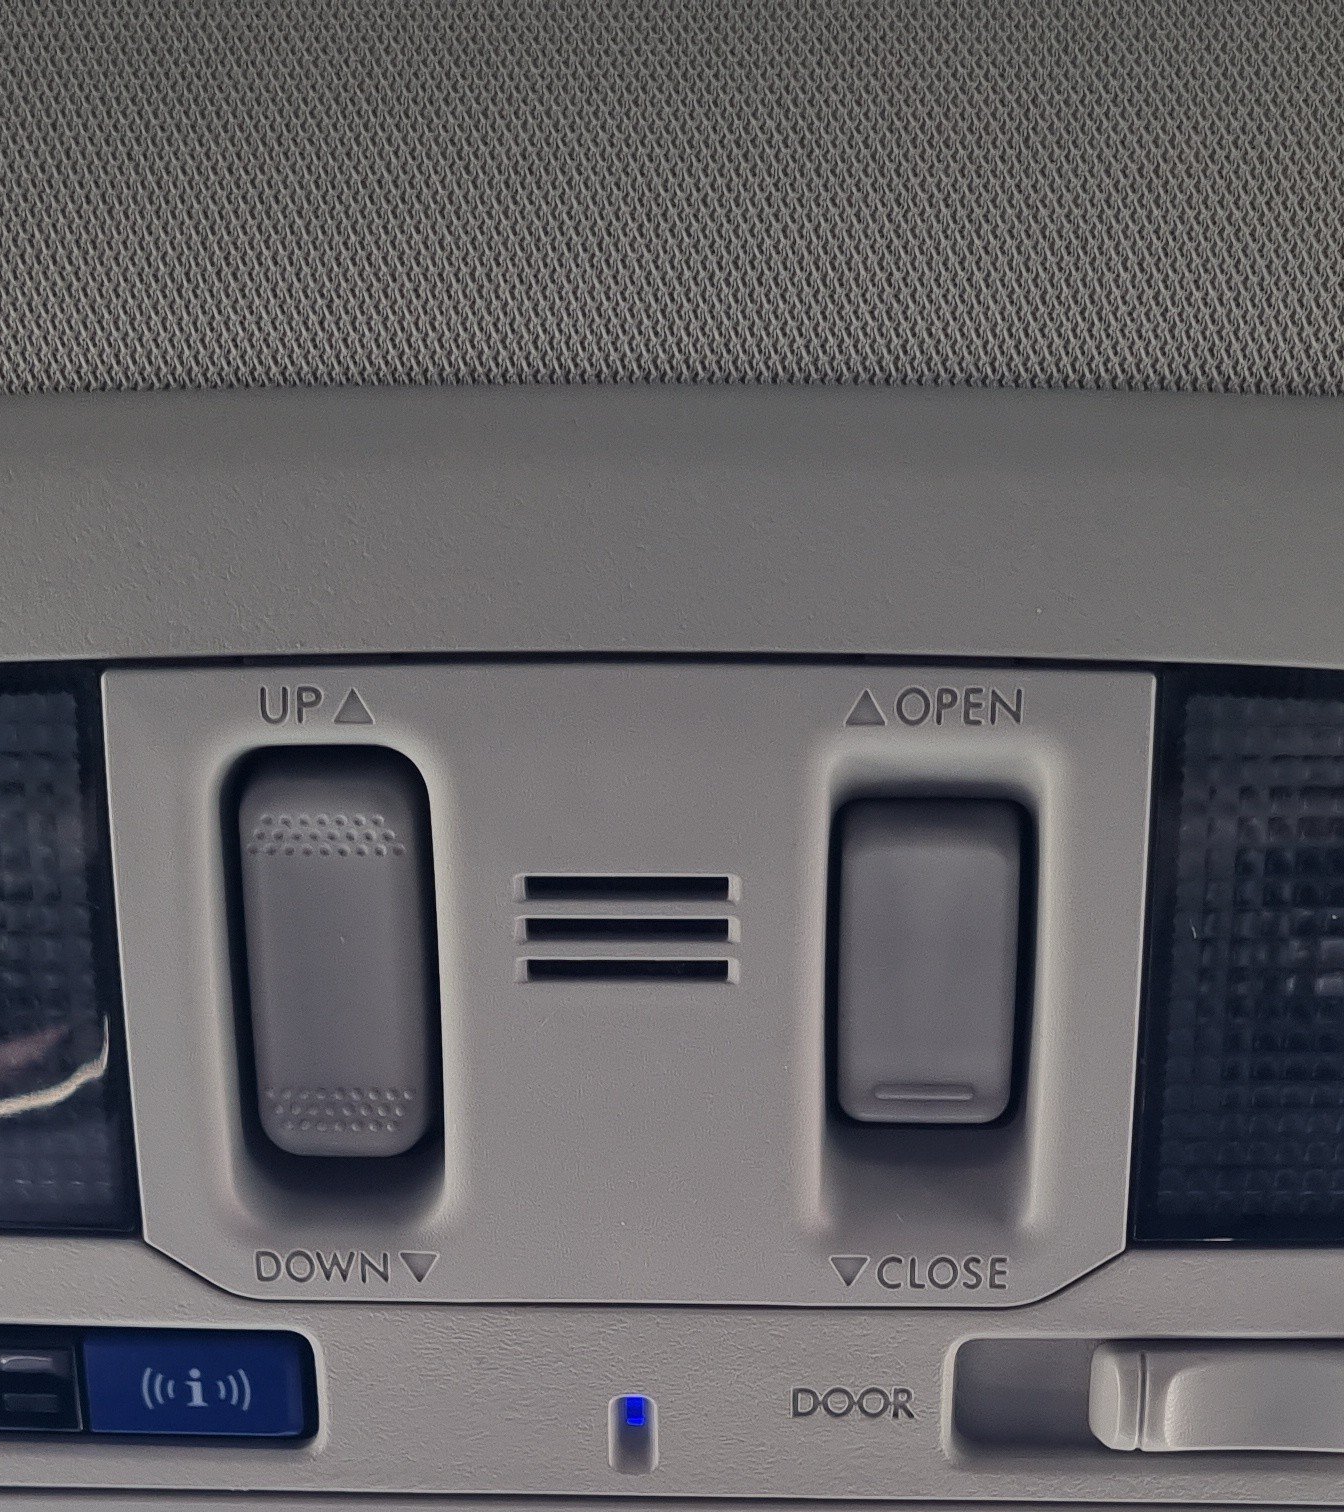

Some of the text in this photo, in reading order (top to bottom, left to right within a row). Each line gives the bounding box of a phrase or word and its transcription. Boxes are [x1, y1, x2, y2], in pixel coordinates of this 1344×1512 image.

[260, 686, 322, 725] UP
[895, 687, 1024, 726] OPEN
[255, 1249, 390, 1284] DOWN
[876, 1256, 1010, 1292] CLOSE
[790, 1385, 916, 1421] DOOR
